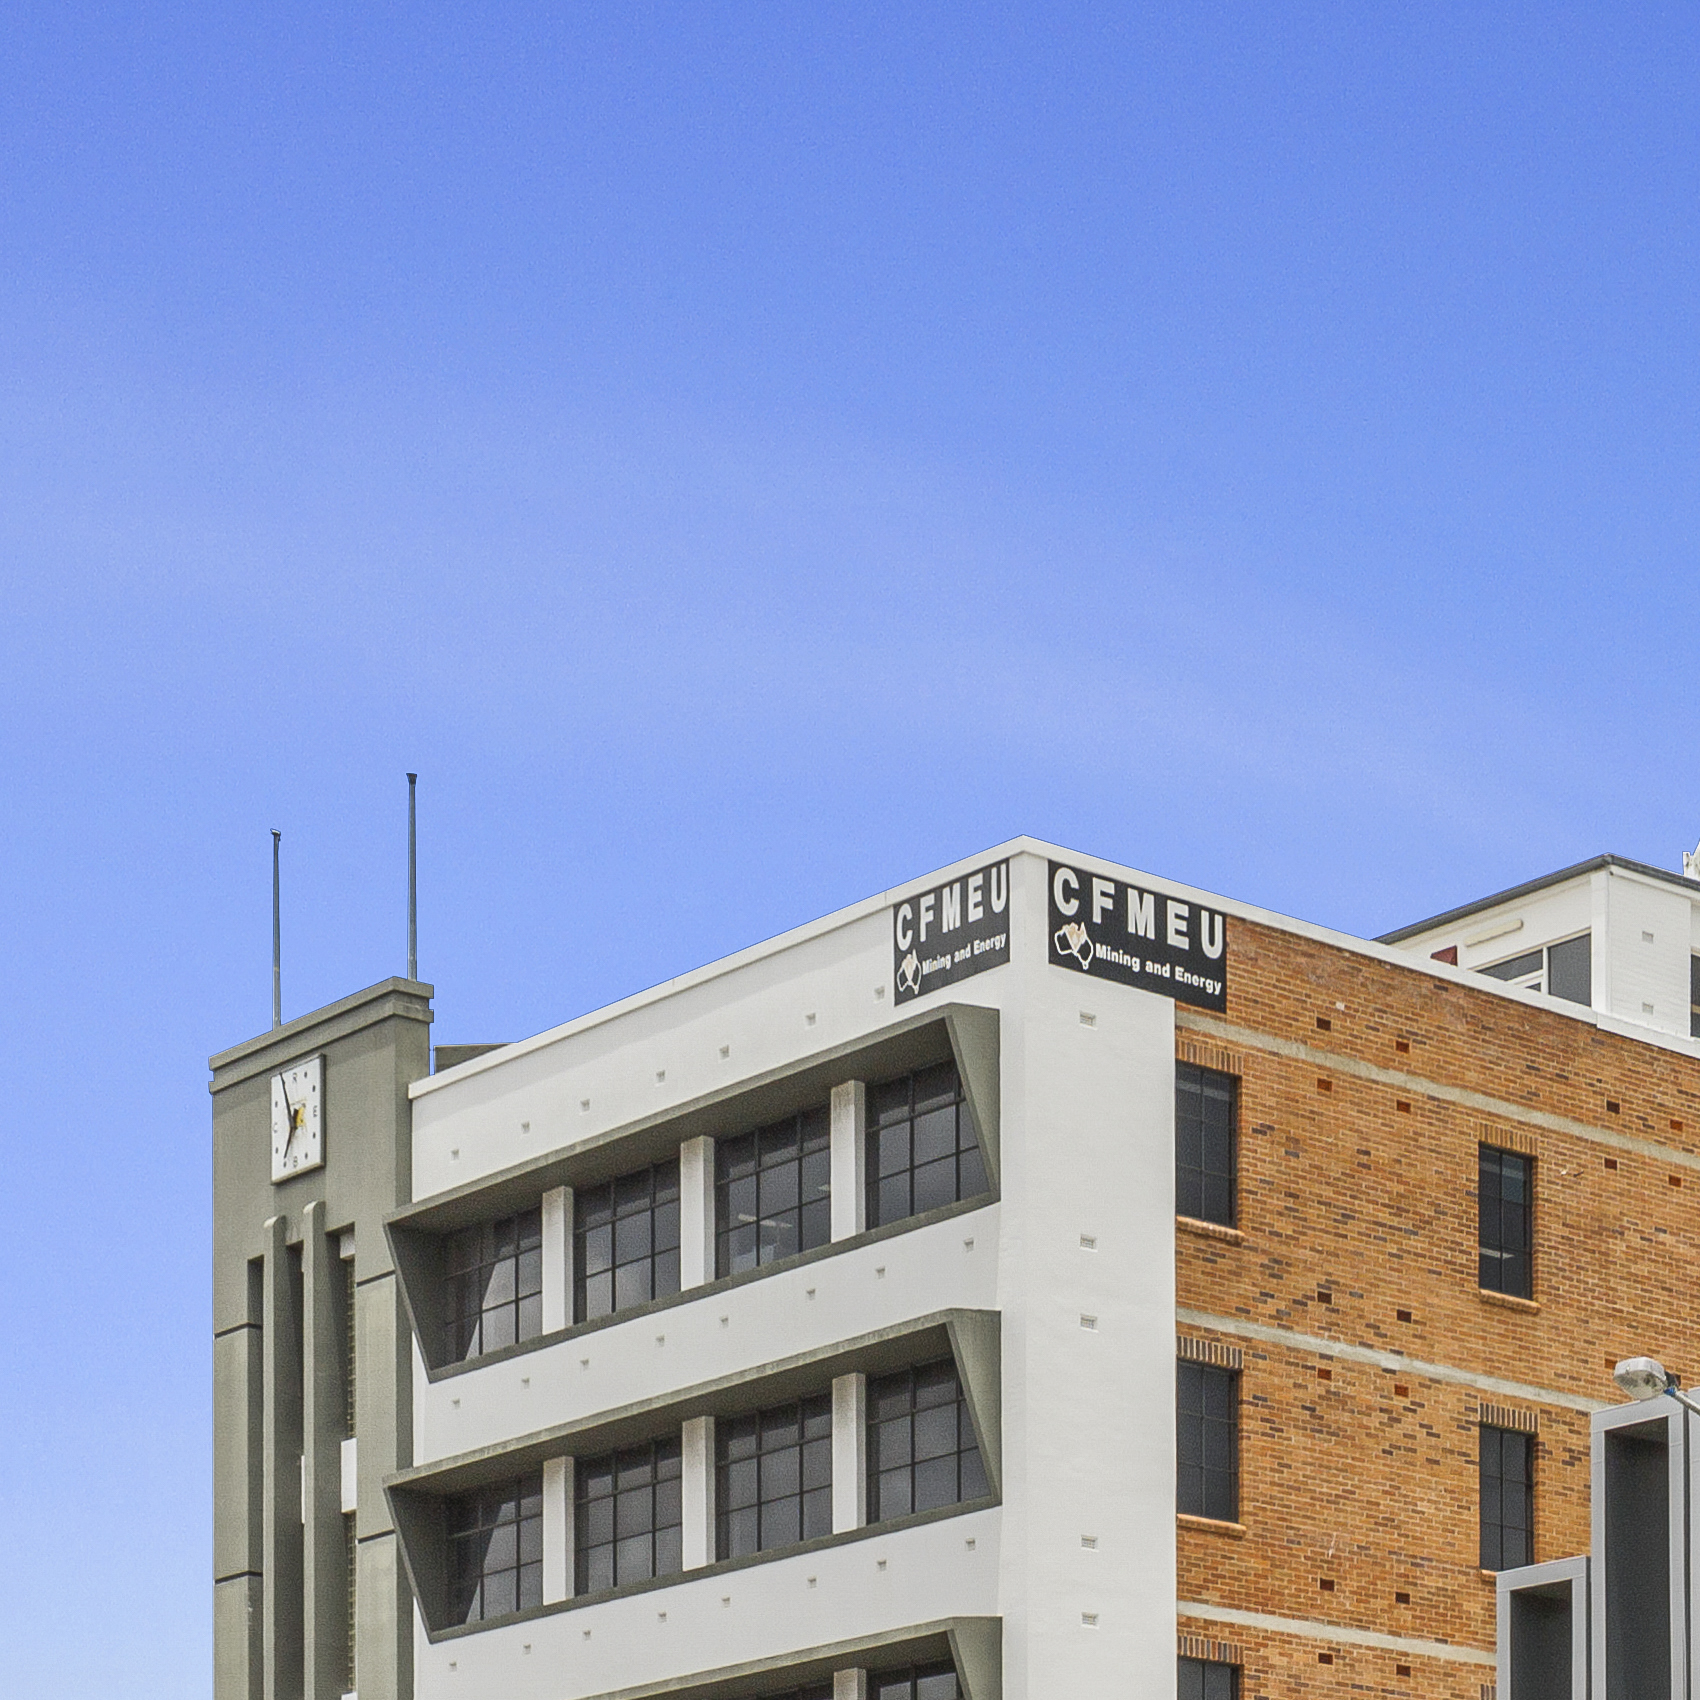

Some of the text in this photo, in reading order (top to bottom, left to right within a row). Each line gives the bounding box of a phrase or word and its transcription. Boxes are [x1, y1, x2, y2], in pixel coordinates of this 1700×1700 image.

[896, 863, 1007, 951] CFMEU
[1053, 867, 1223, 959] CFMEU
[922, 933, 1006, 975] Mining and Energy
[1096, 943, 1222, 995] Mining and Energy
